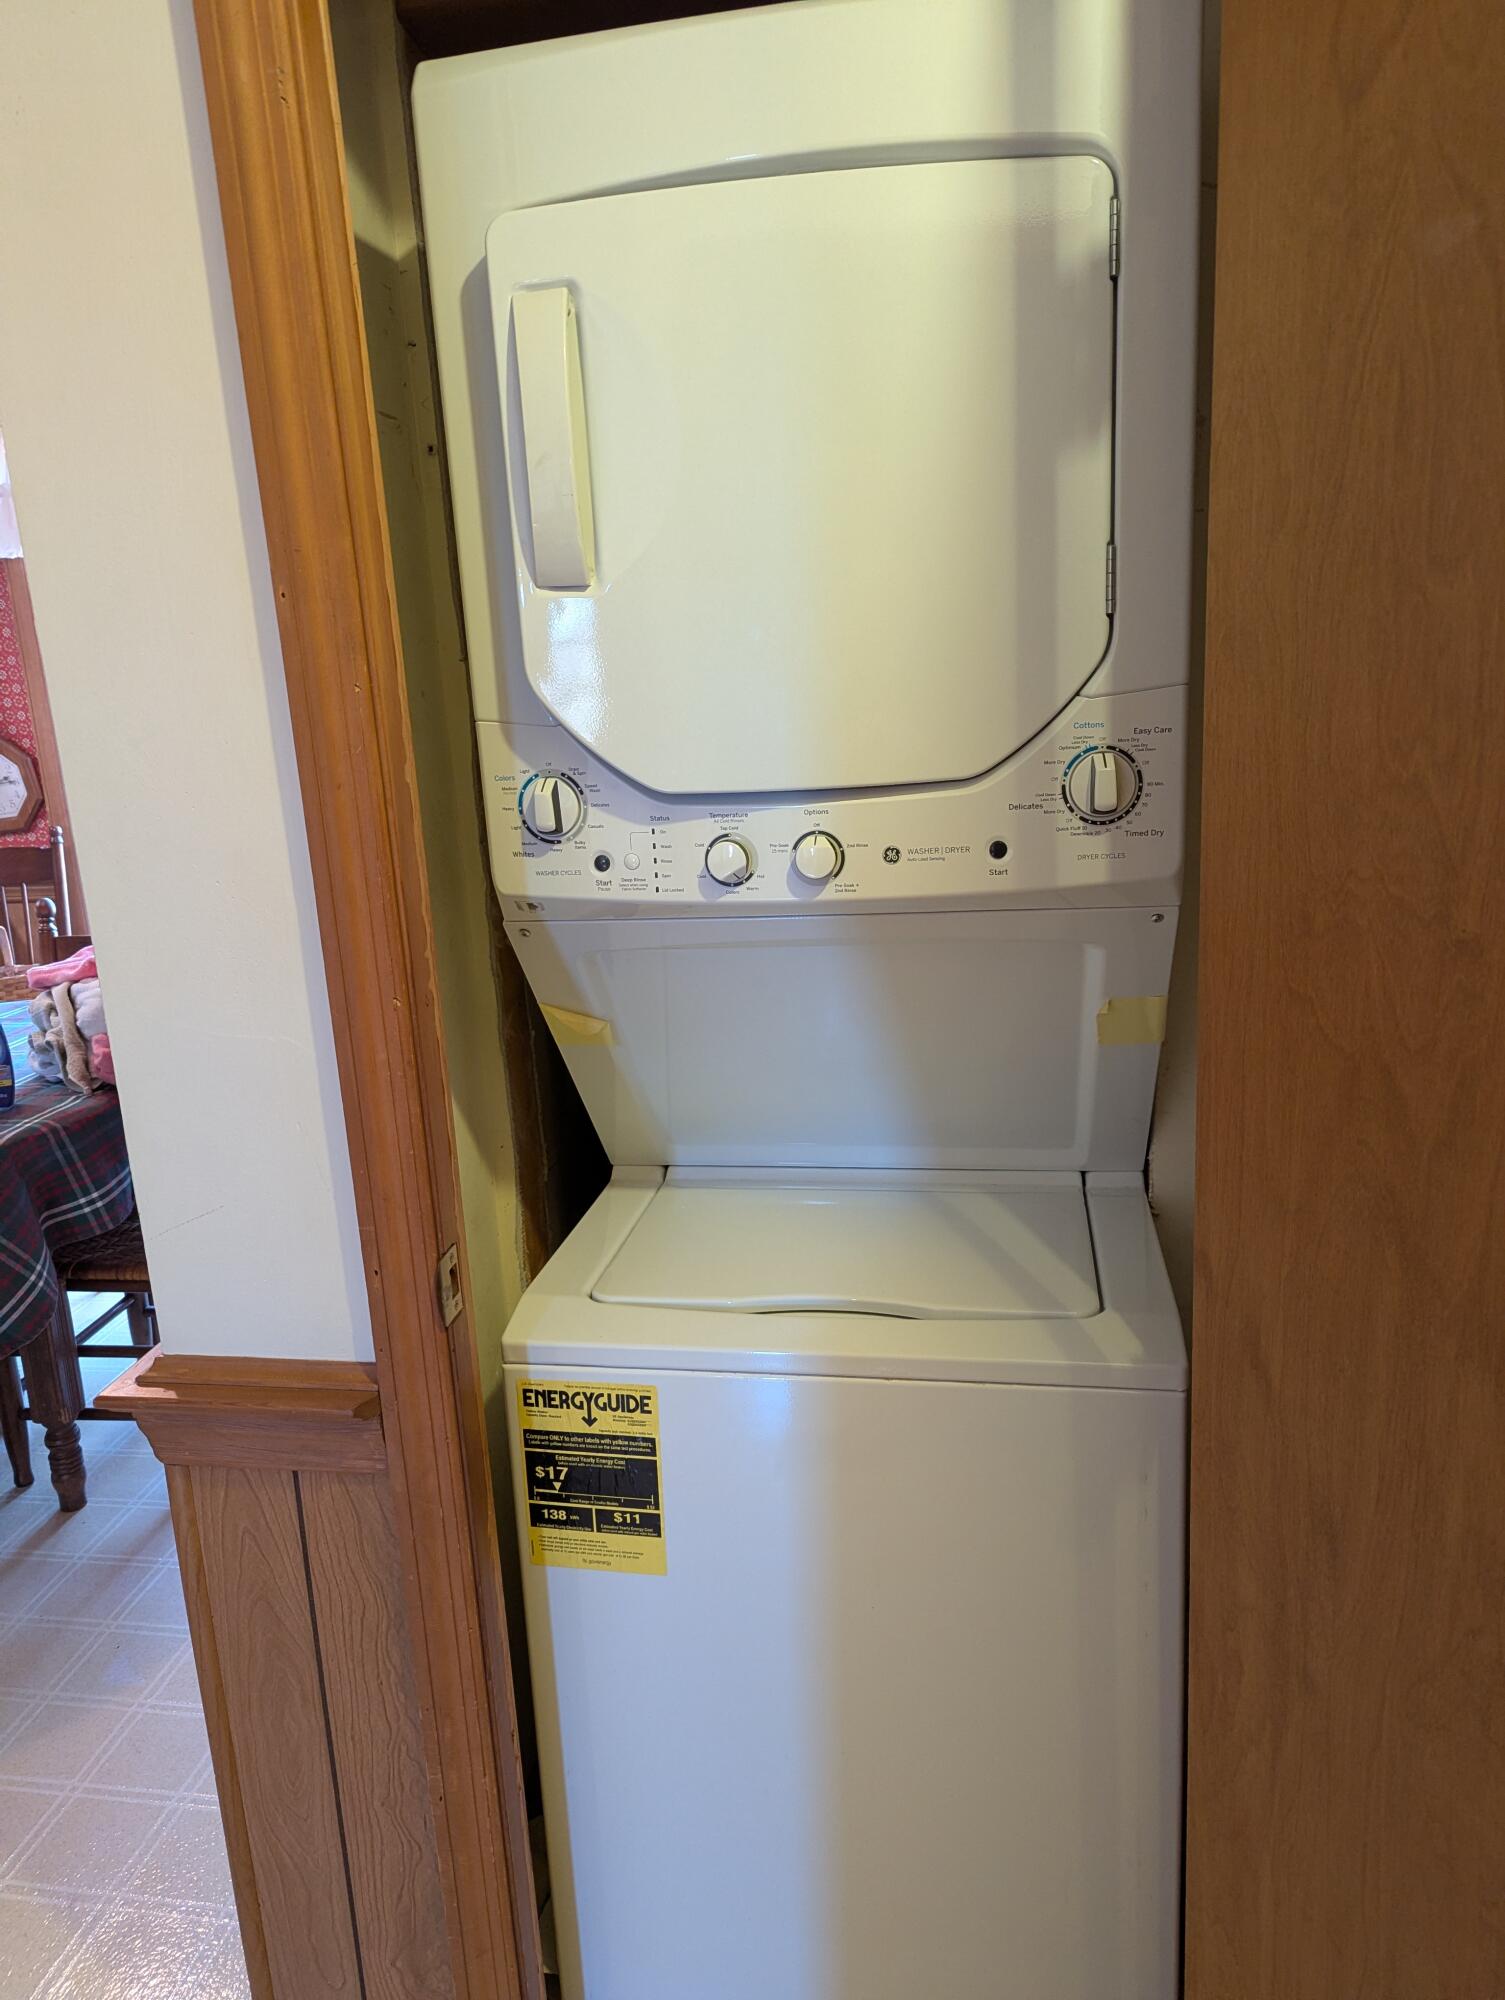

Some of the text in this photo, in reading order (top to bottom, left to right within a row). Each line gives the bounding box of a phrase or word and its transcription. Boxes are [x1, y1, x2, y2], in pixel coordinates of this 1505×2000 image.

[1133, 726, 1173, 735] Easy Care
[1008, 803, 1044, 811] Delicates
[1150, 829, 1165, 838] Dry
[907, 846, 971, 855] WASHER DRYER
[1077, 852, 1127, 861] DRYER CYCLES
[522, 1388, 653, 1416] ENERGYGUIDE
[526, 1433, 548, 1441] Compare
[580, 1456, 595, 1464] Yearly
[535, 1466, 568, 1480] $17
[541, 1509, 567, 1520] 138
[613, 1512, 640, 1524] $11
